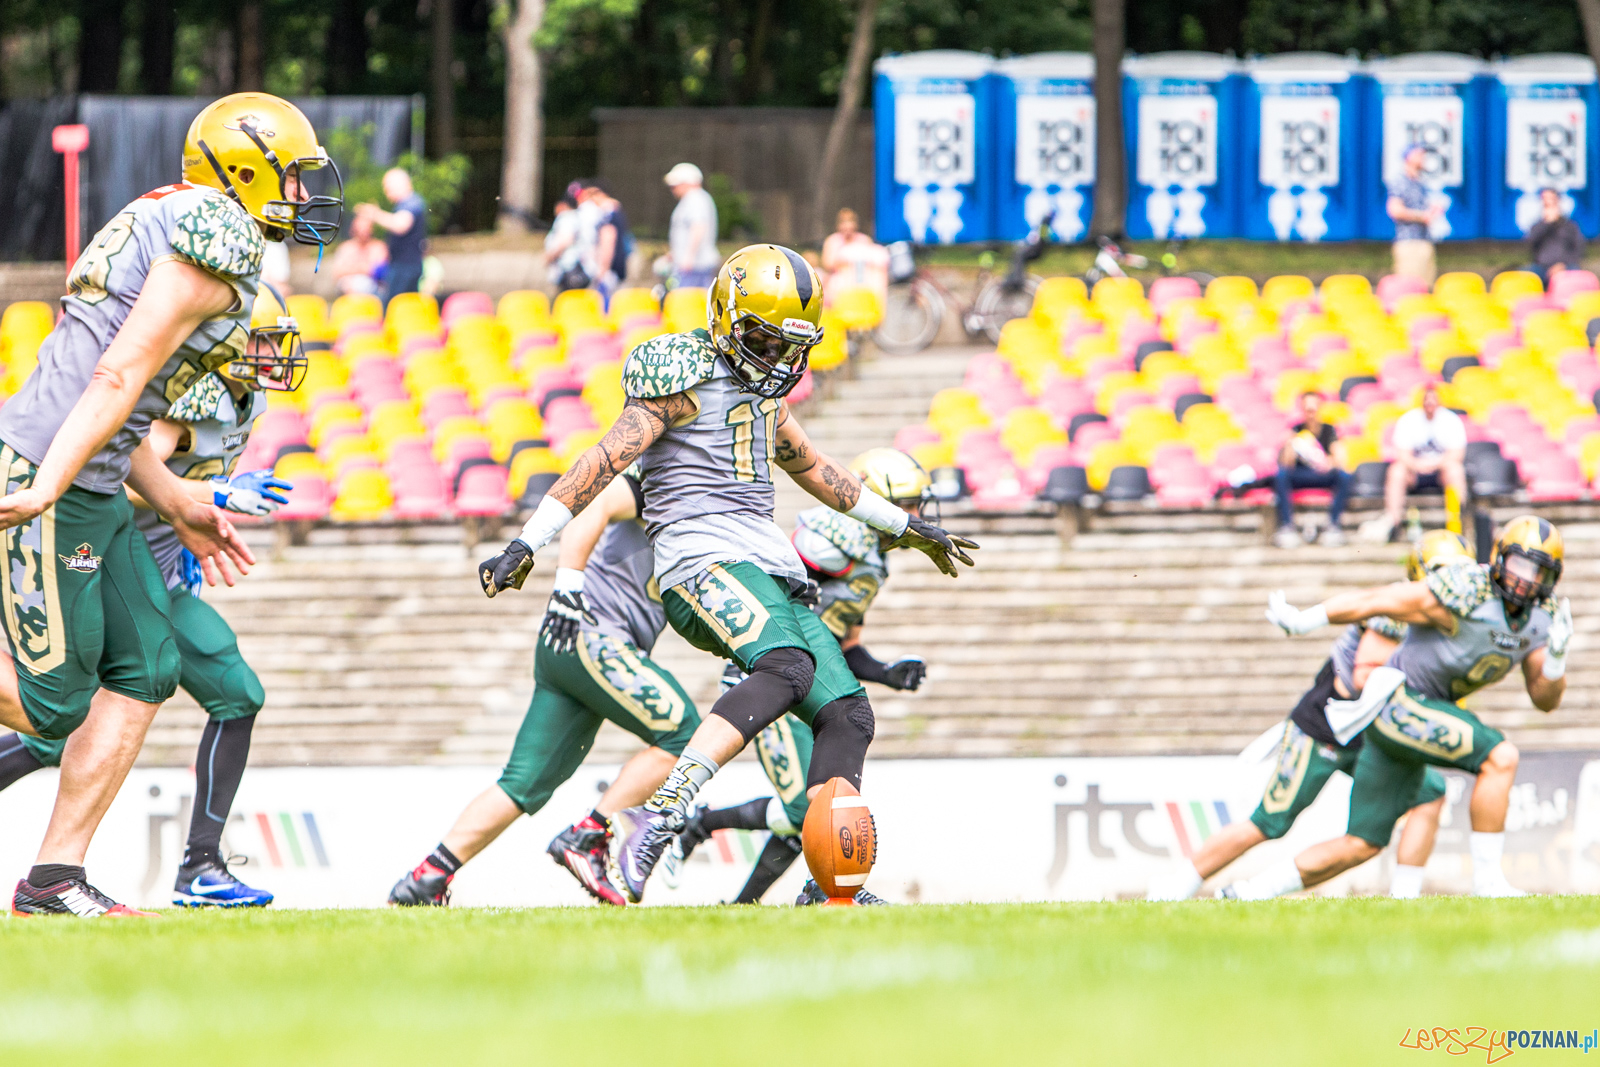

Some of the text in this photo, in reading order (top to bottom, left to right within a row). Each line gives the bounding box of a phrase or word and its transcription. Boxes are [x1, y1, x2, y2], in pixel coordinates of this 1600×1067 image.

[791, 321, 810, 330] Riddell
[69, 558, 98, 569] ARMIA
[859, 817, 869, 862] Wilson
[1047, 774, 1170, 888] jtc
